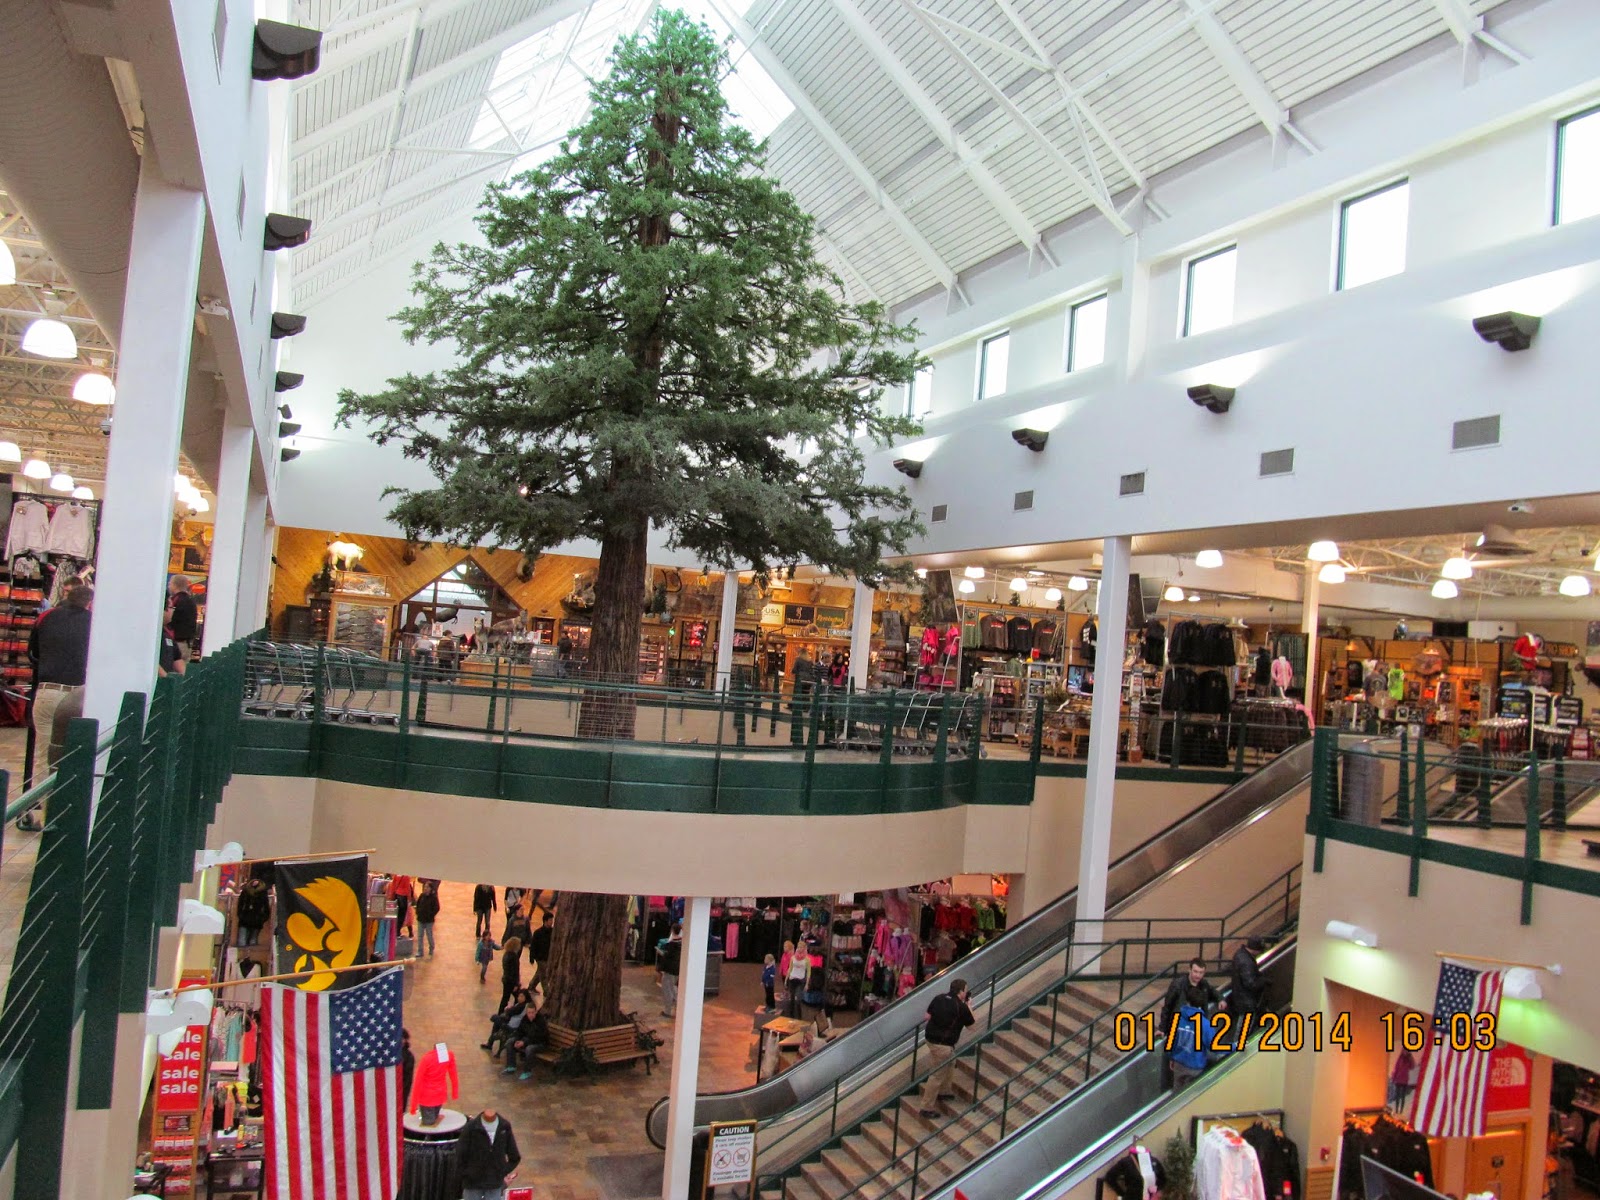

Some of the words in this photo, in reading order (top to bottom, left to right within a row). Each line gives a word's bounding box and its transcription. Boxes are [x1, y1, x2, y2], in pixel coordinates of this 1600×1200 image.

[162, 1065, 200, 1080] sale
[161, 1080, 199, 1095] sale
[1490, 1077, 1512, 1087] ACE
[719, 1126, 750, 1136] CAUTION
